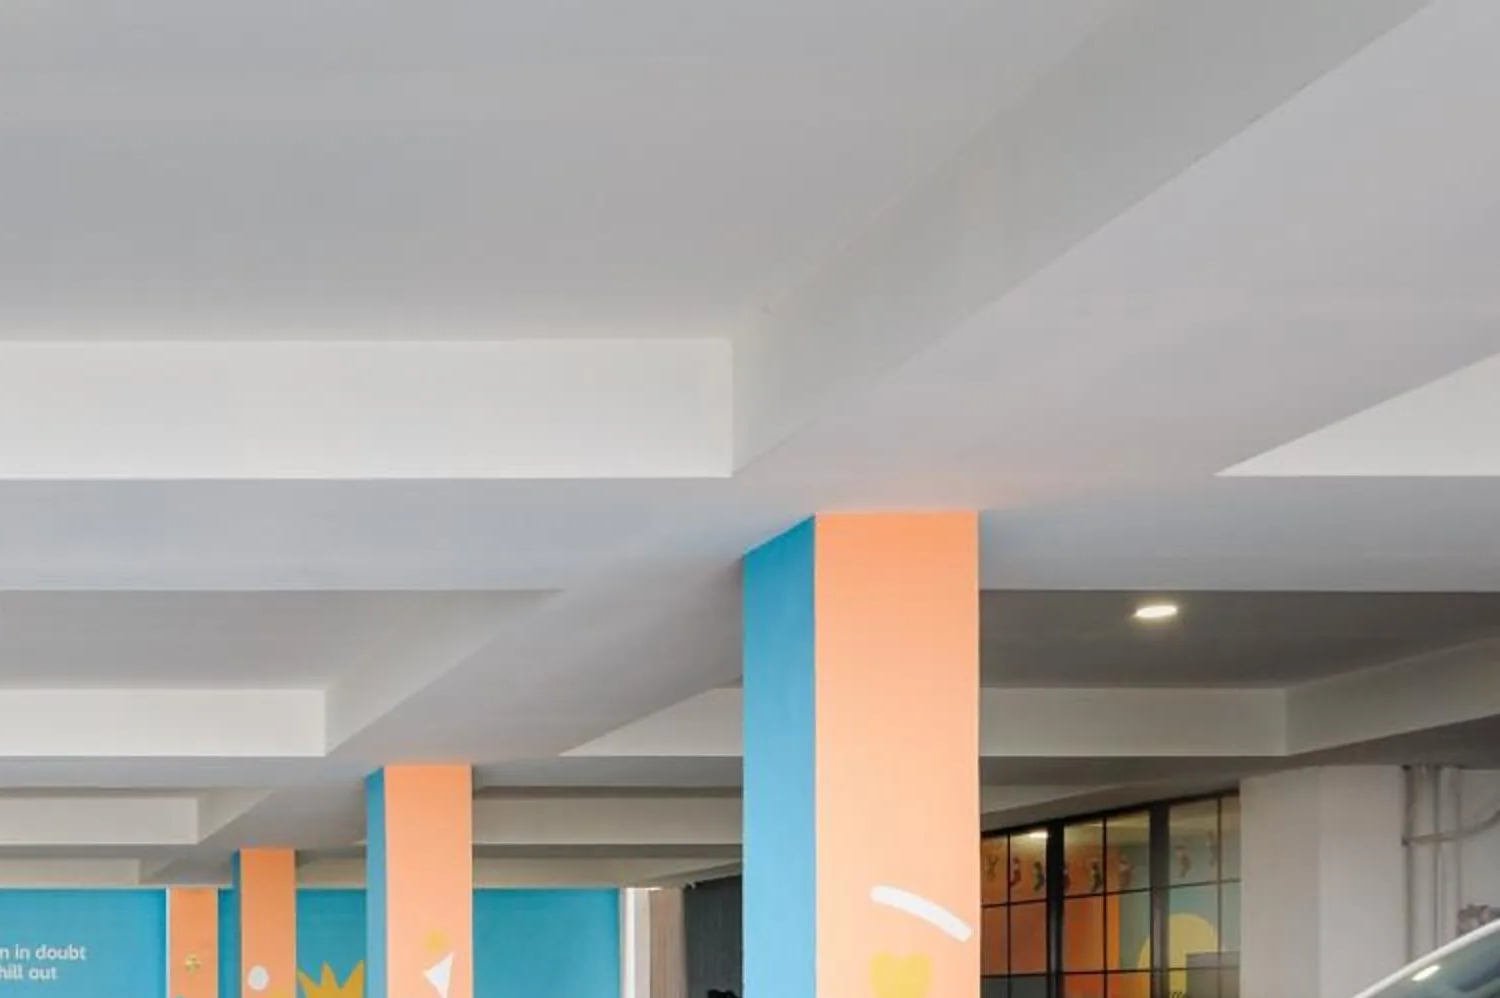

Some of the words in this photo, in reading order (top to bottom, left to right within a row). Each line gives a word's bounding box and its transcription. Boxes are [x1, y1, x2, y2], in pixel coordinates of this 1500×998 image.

[14, 944, 30, 961] in
[35, 944, 86, 961] doubt
[28, 966, 57, 980] out
